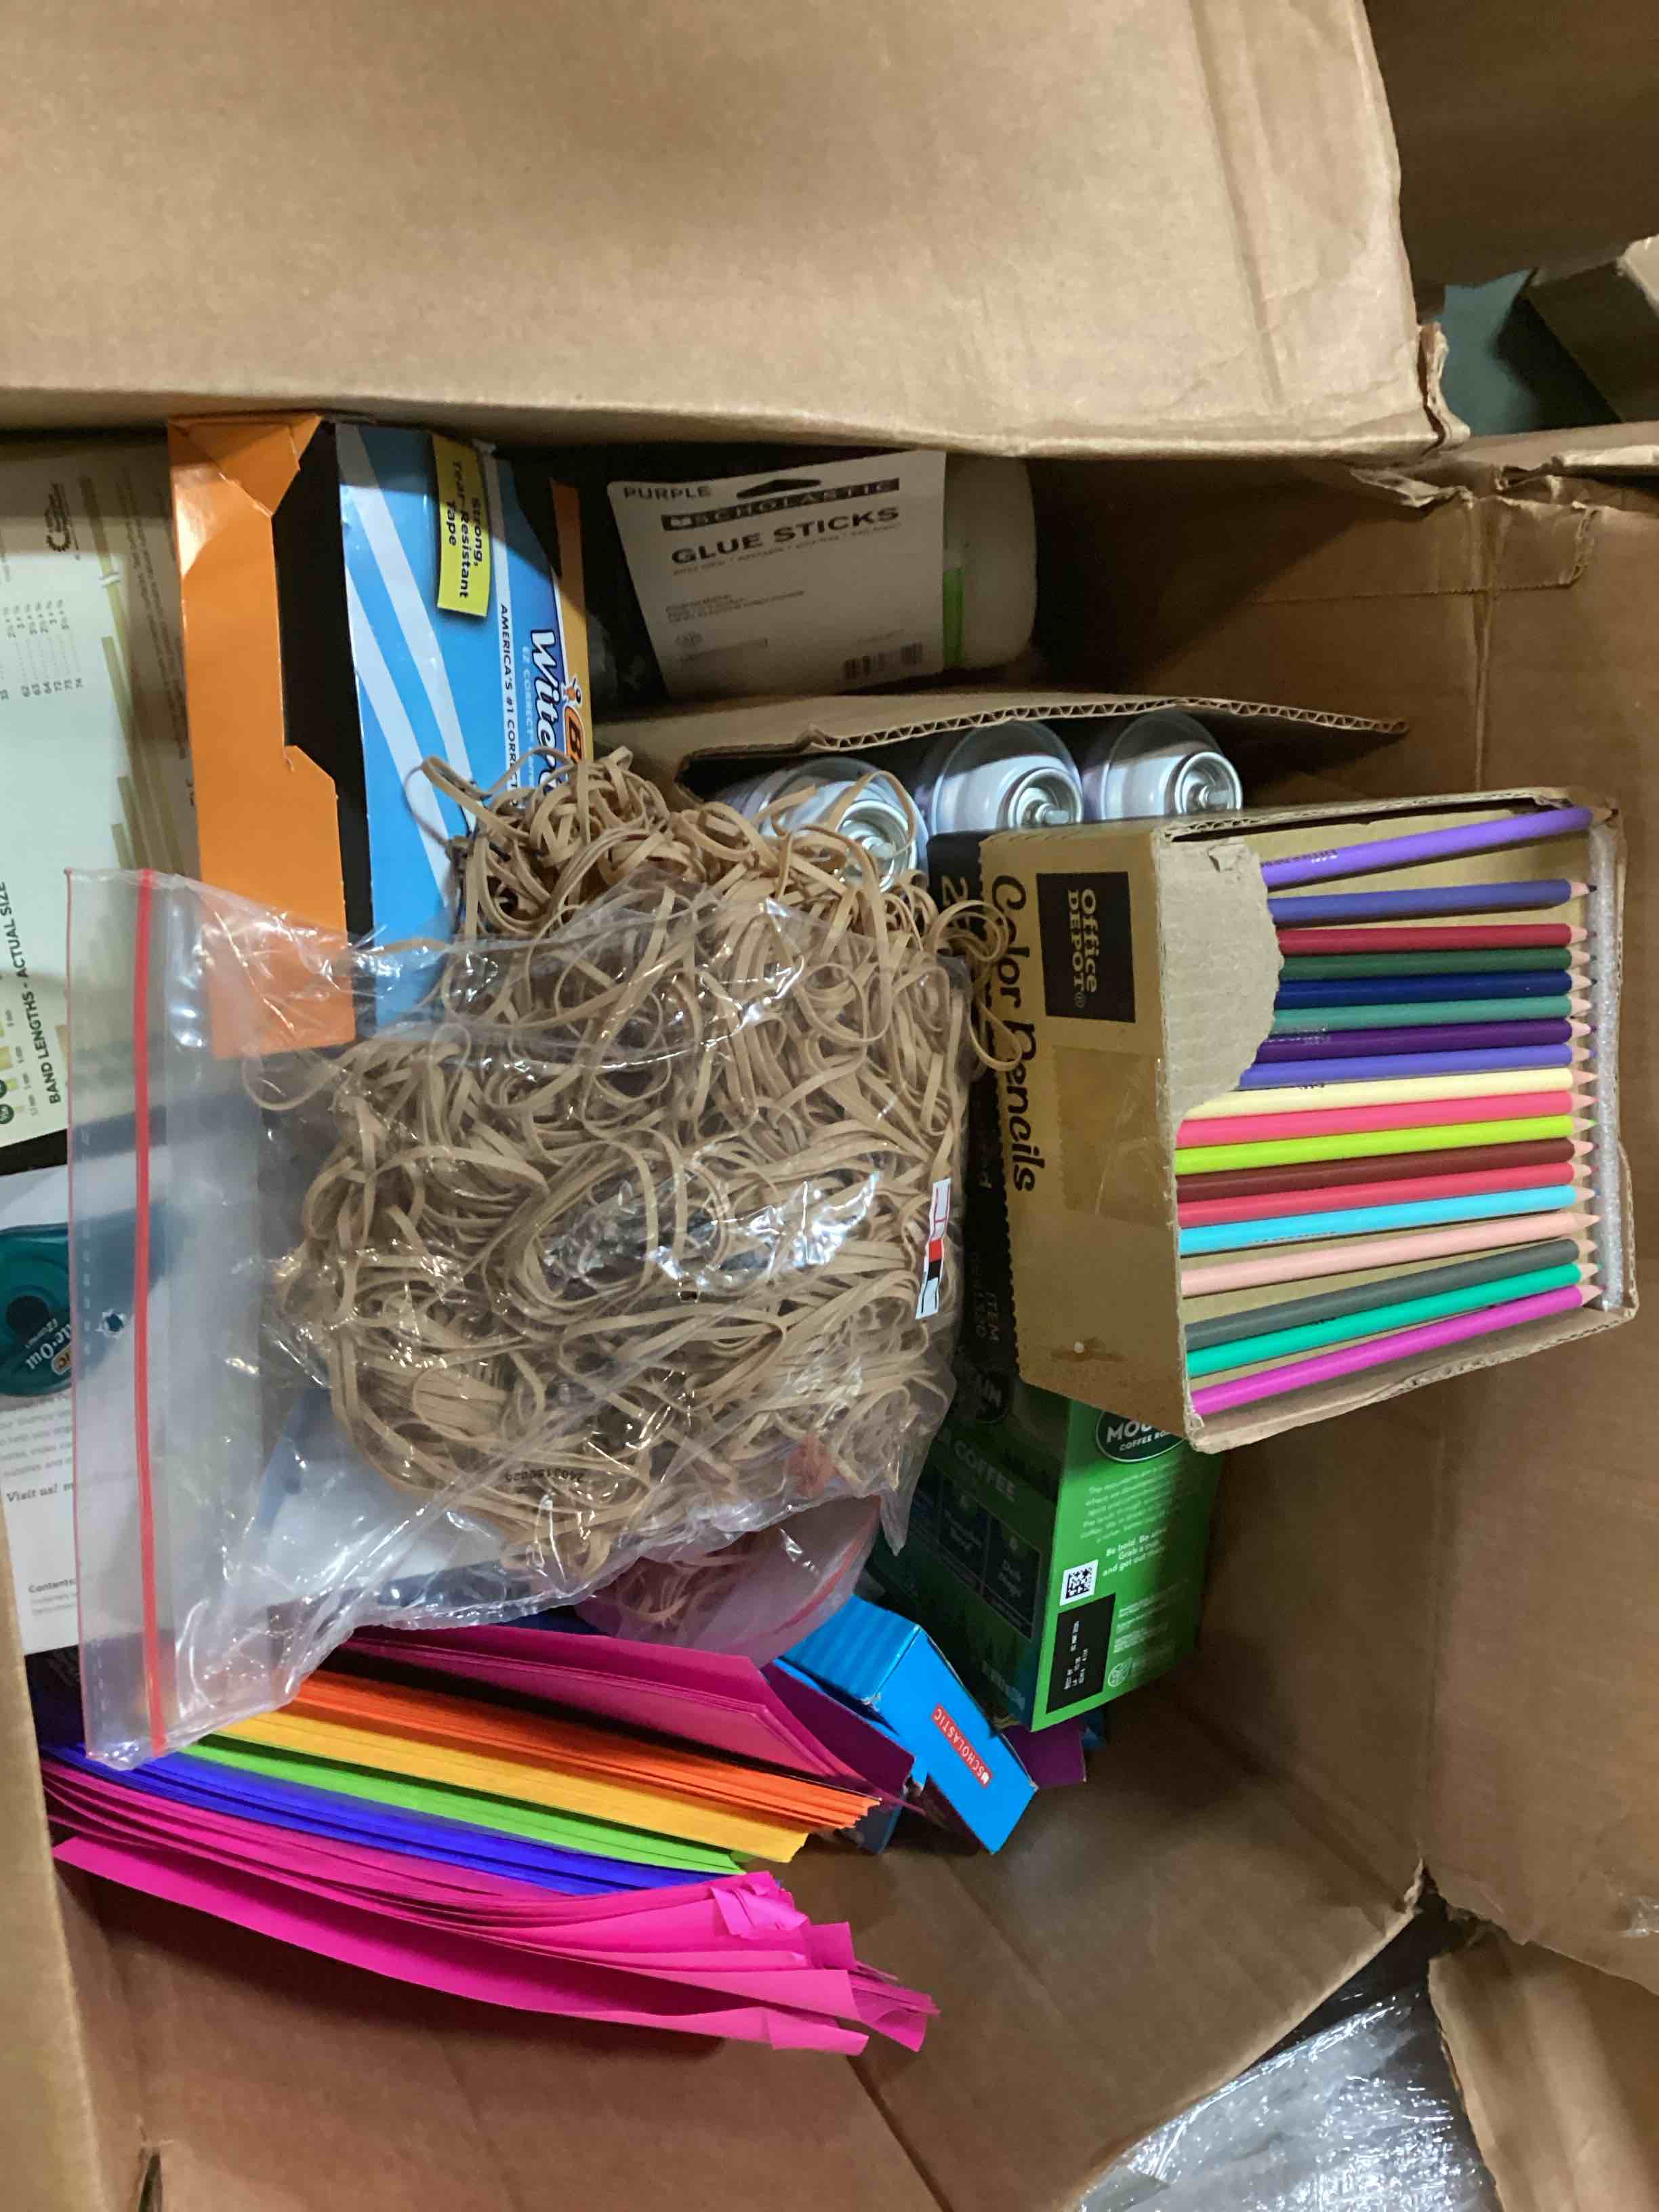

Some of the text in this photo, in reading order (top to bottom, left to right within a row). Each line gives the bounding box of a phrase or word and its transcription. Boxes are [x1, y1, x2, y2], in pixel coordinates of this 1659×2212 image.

[446, 498, 457, 546] Tape
[622, 485, 712, 500] PURPLE
[472, 497, 483, 567] Strong,
[671, 533, 763, 565] GLUE
[773, 506, 900, 544] STICKS
[500, 604, 514, 691] AMERICA'S
[505, 696, 514, 713] #1
[3, 918, 29, 979] ACTUAL
[1083, 888, 1100, 994] Office
[22, 991, 49, 1059] LENGTHS
[41, 1062, 62, 1105] BAND
[1119, 1434, 1152, 1451] COFFEE
[7, 1490, 37, 1502] Visit
[933, 1706, 985, 1778] SCHOLASTIC
